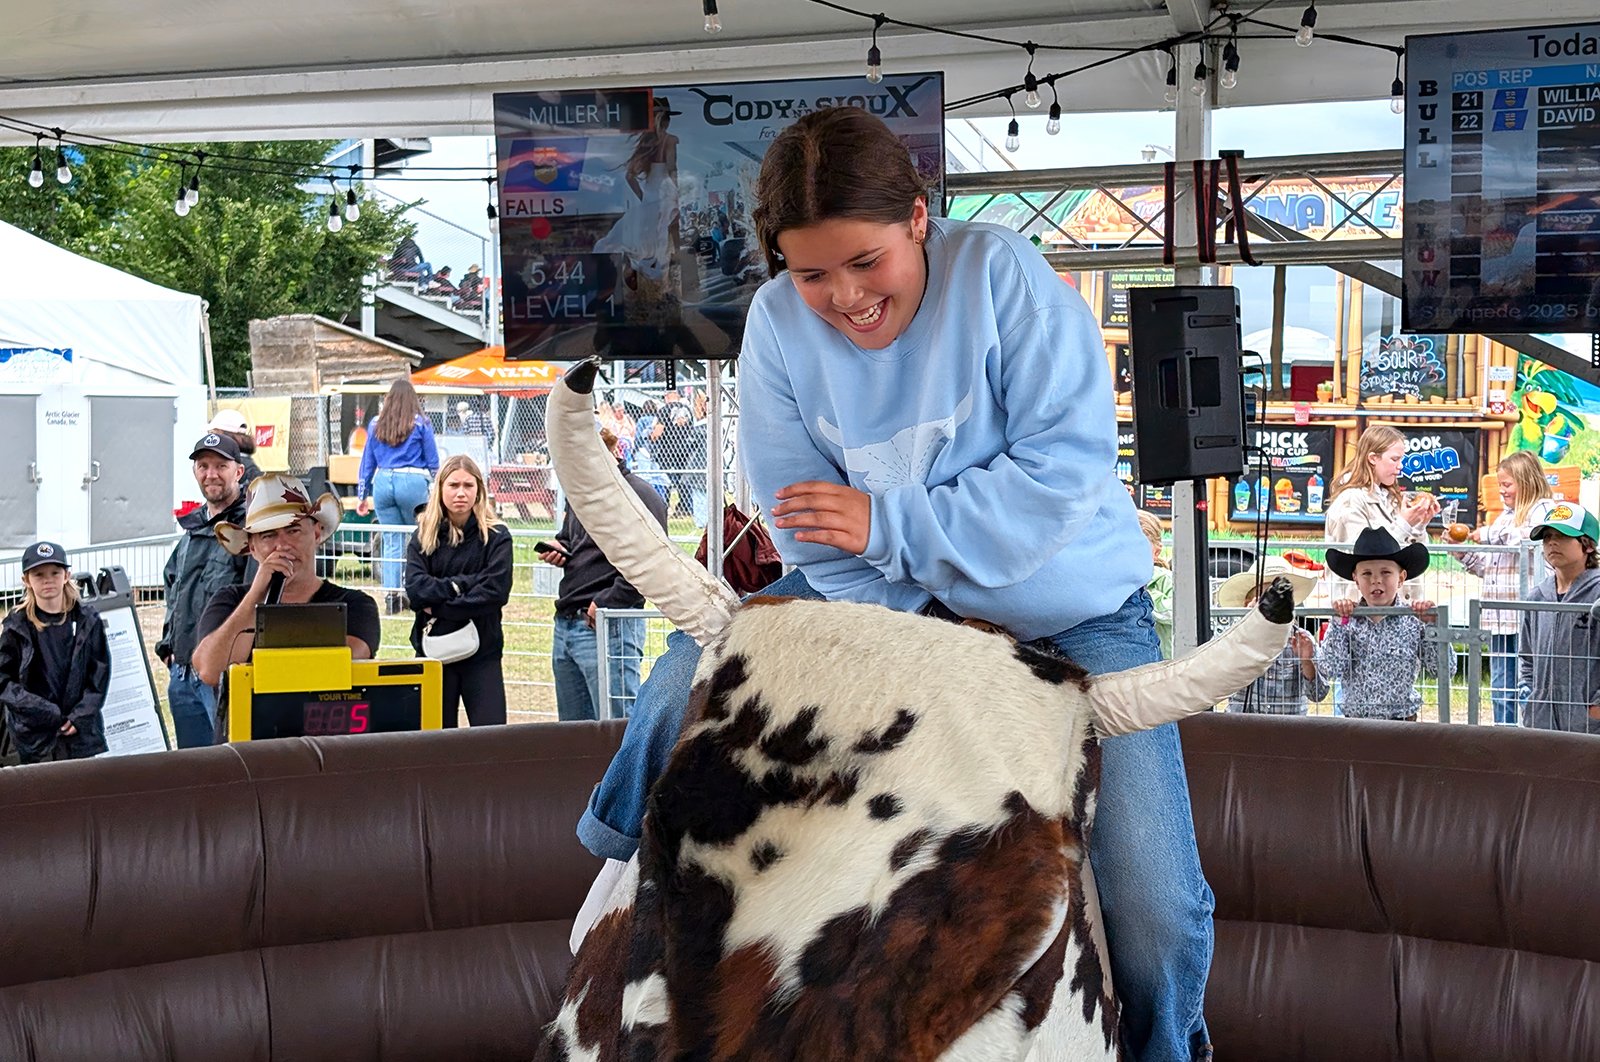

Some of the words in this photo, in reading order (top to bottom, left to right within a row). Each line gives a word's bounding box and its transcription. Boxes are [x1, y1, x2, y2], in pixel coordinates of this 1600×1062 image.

[1527, 32, 1600, 58] Toda
[1453, 71, 1488, 87] POS
[1499, 68, 1533, 84] REP
[1460, 93, 1479, 108] 21
[528, 105, 598, 127] MILLER
[605, 103, 621, 123] H
[1459, 115, 1479, 129] 22
[1543, 107, 1596, 124] DAVID
[505, 198, 564, 217] FALLS
[1330, 190, 1400, 229] ICE
[529, 260, 585, 288] 5.44
[510, 295, 597, 320] LEVEL
[606, 296, 615, 318] 1
[1527, 303, 1579, 319] 2025
[477, 366, 550, 378] VIZZY
[1255, 431, 1309, 449] PICK
[1286, 447, 1309, 456] CUP
[318, 693, 342, 702] YOUR
[342, 692, 362, 701] TIME
